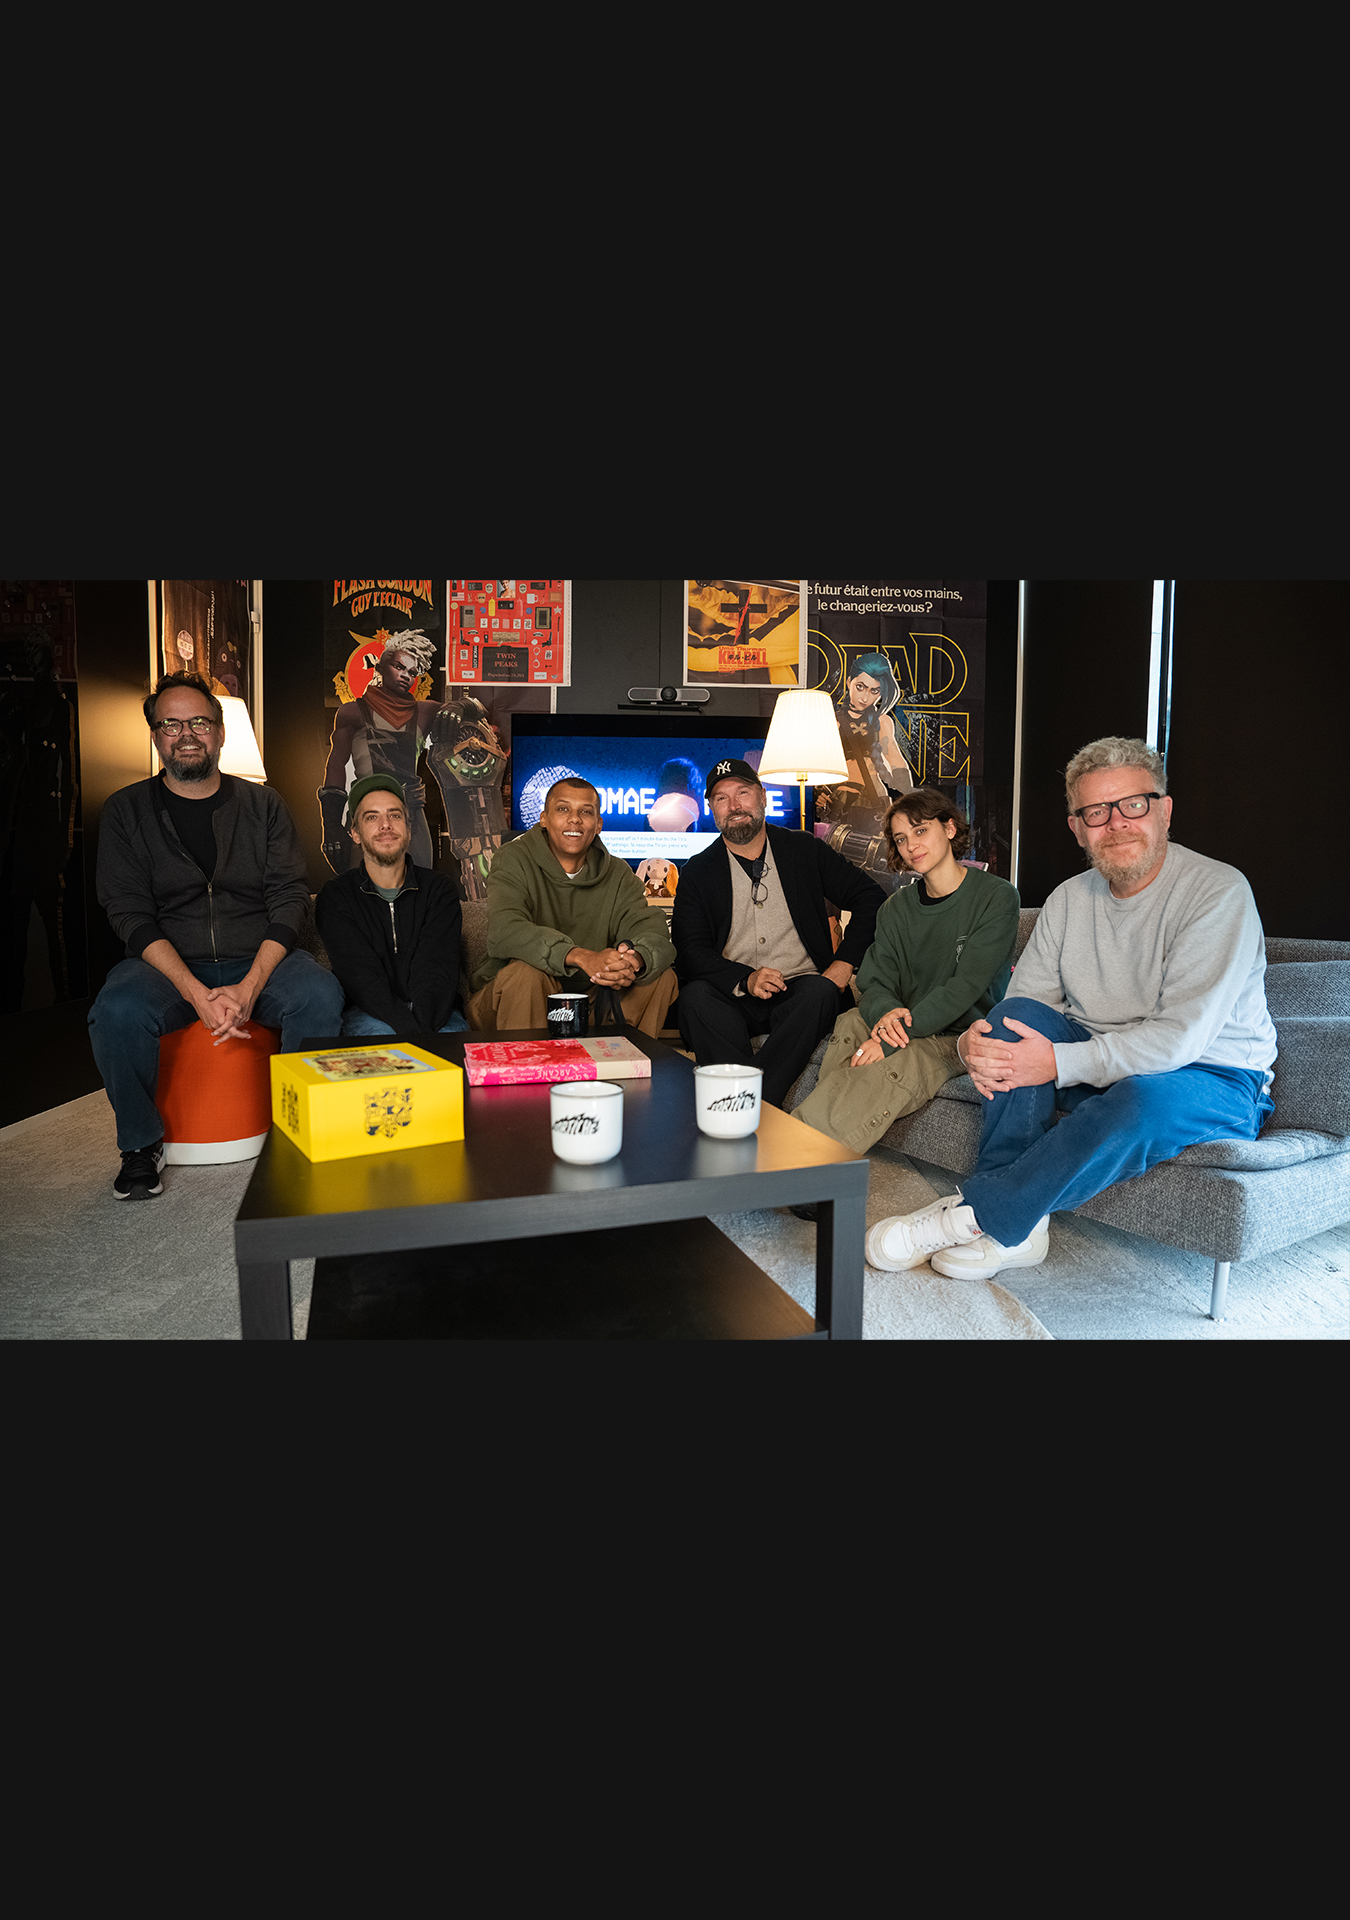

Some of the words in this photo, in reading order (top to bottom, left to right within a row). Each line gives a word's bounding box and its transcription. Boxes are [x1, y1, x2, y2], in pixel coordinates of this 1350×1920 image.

[814, 583, 843, 595] futur
[844, 584, 870, 597] était
[871, 586, 902, 598] entre
[903, 588, 923, 598] vos
[925, 588, 963, 601] mains,
[351, 592, 373, 618] GUY
[817, 599, 828, 611] le
[716, 760, 732, 776] NY
[537, 1068, 571, 1078] ARCANE
